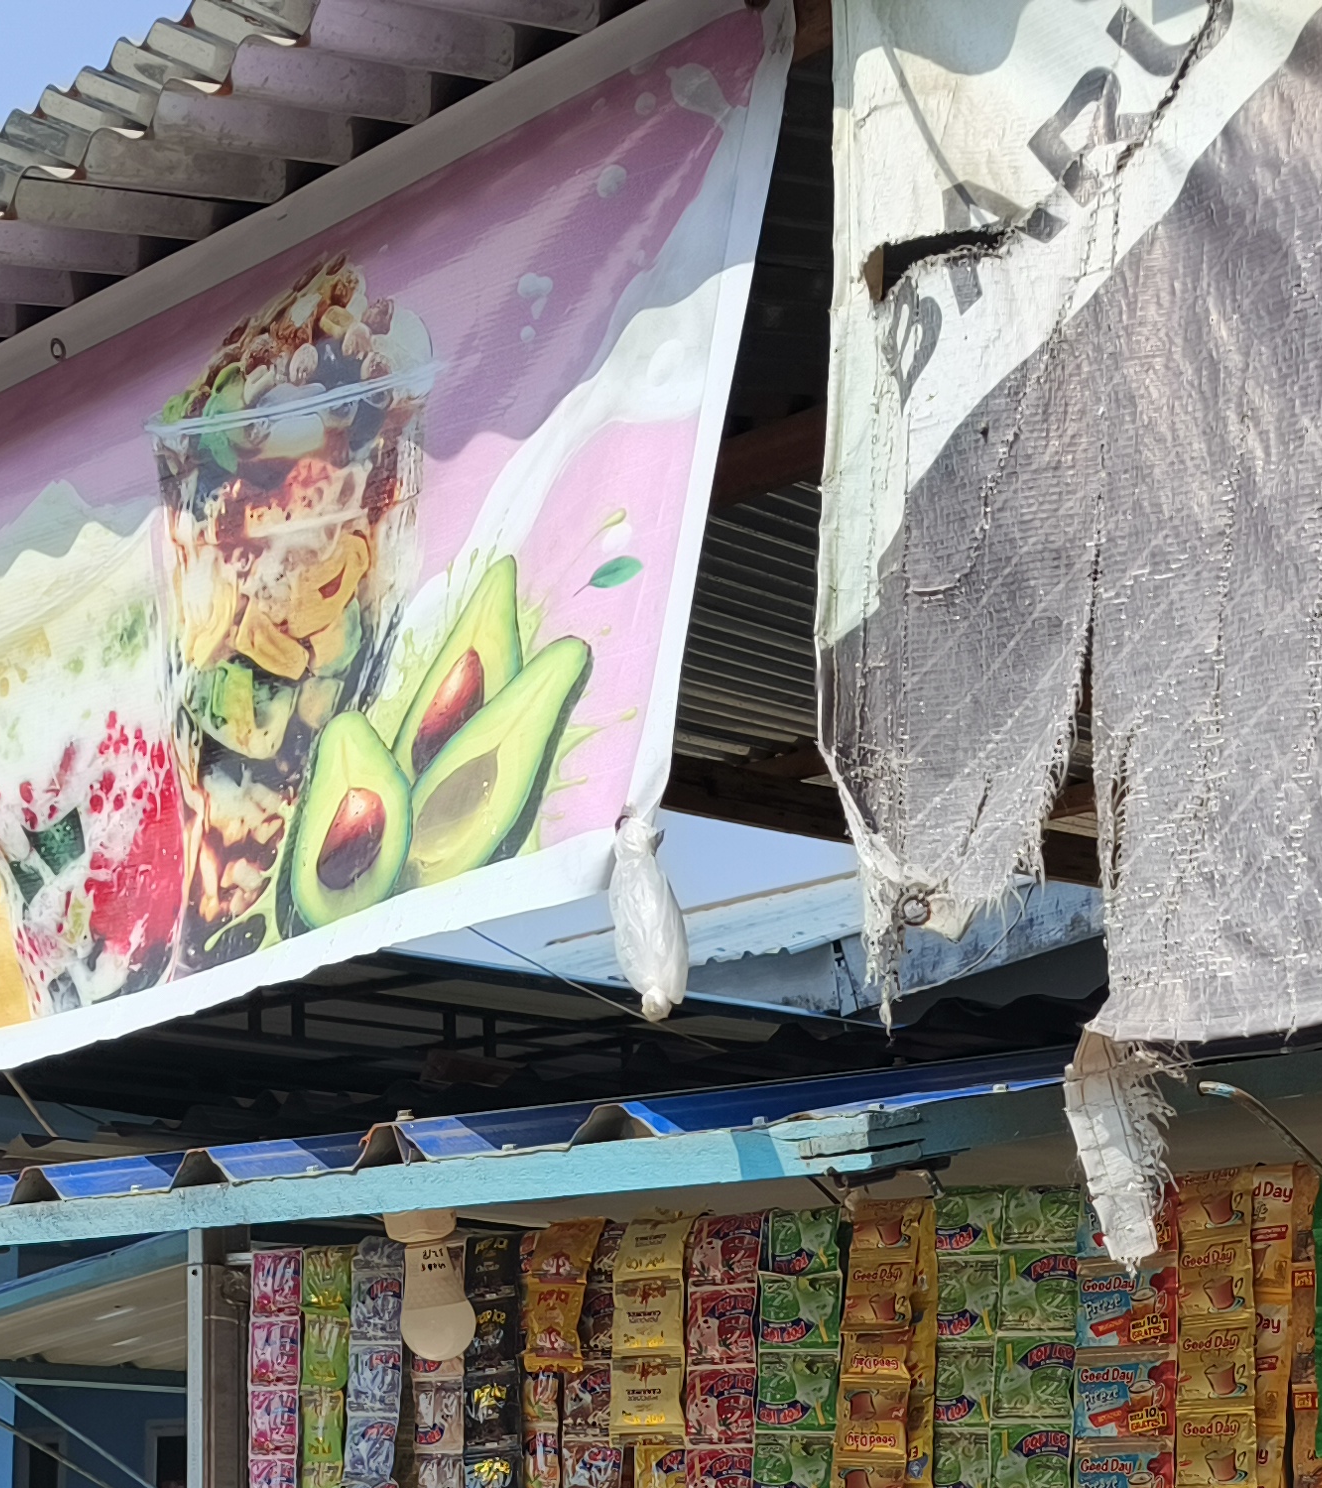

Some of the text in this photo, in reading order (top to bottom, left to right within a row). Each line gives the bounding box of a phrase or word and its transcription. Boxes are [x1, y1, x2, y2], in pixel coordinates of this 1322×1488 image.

[1262, 1180, 1293, 1202] Day
[1181, 1249, 1235, 1268] Good Day
[1081, 1276, 1136, 1293] Good Day
[1182, 1335, 1240, 1351] Good Day
[1080, 1367, 1134, 1384] Good Day
[1182, 1420, 1240, 1437] Good Day
[1079, 1458, 1133, 1474] Good Day
